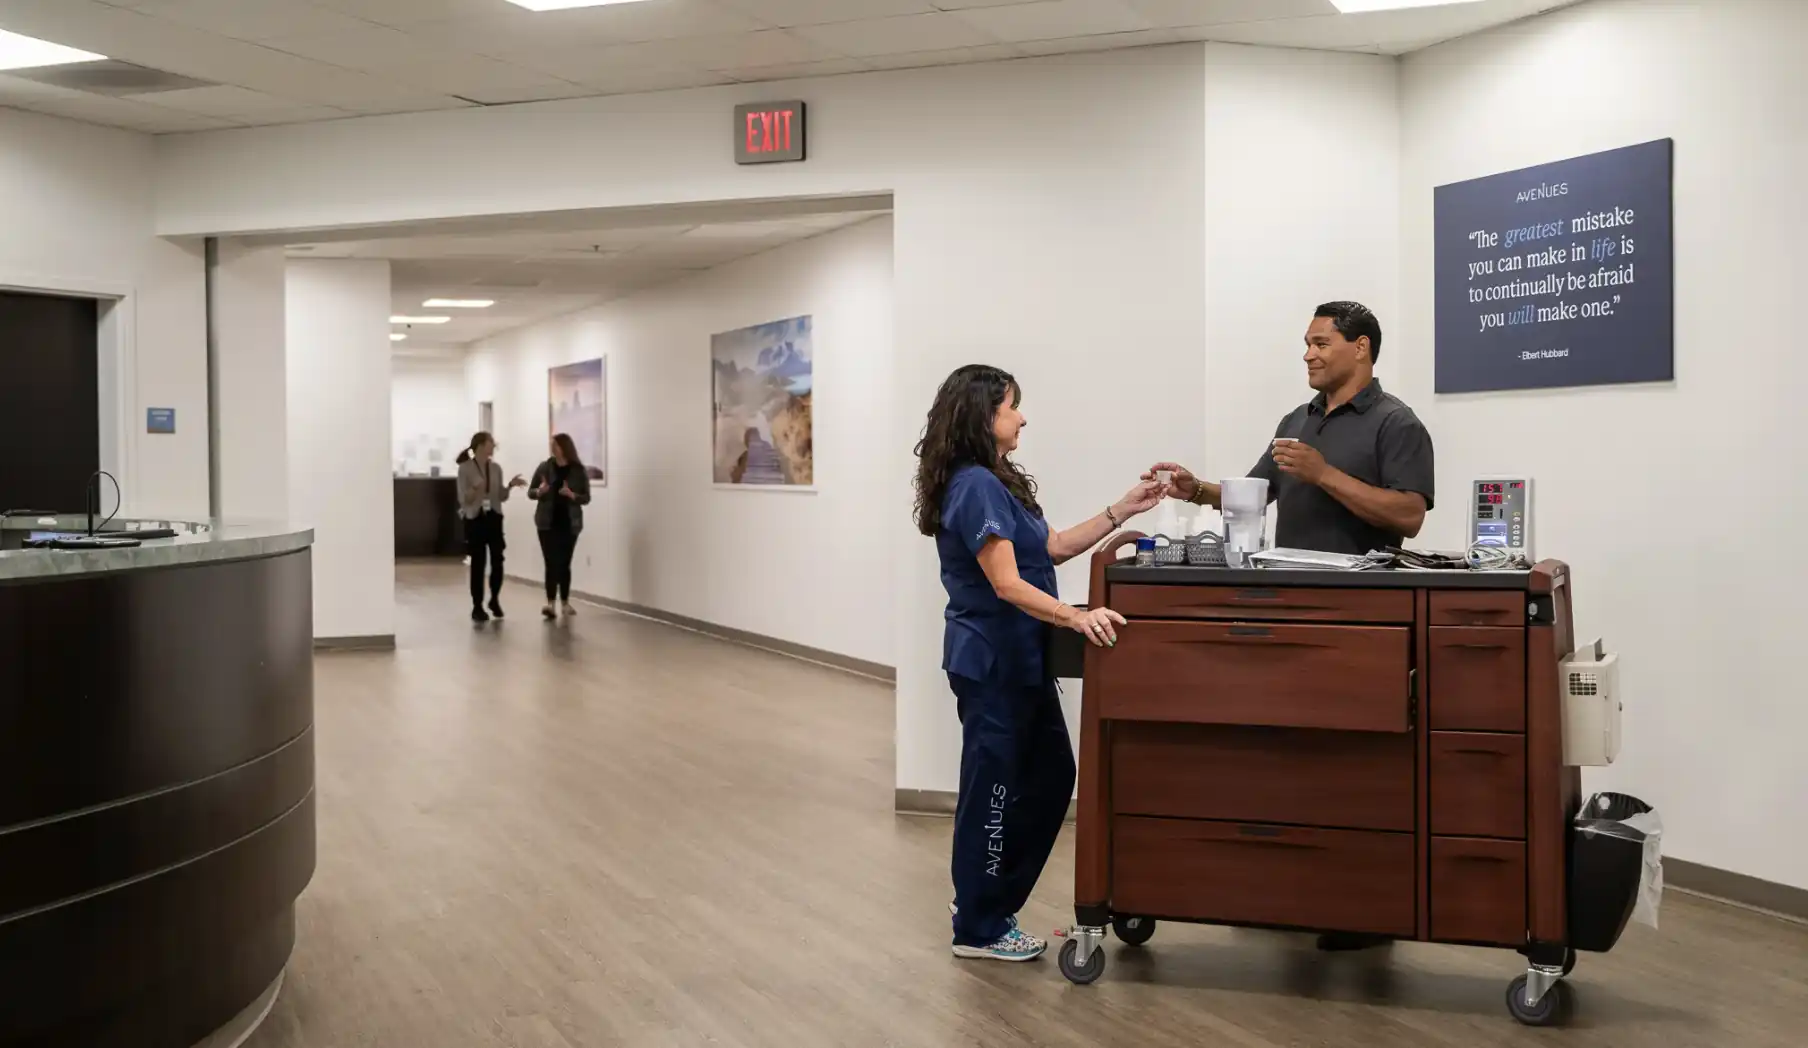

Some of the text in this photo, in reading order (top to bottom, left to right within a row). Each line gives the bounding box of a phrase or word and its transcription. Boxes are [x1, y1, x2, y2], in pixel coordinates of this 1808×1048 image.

[746, 110, 793, 153] EXIT
[1516, 182, 1569, 203] AVENUES
[1504, 219, 1564, 248] greatest
[1572, 206, 1634, 233] mistake
[1468, 234, 1634, 281] you can make in life is
[1469, 263, 1634, 303] to continually be afraid
[1480, 312, 1505, 332] you
[1508, 304, 1535, 325] will
[1537, 300, 1578, 323] make
[1522, 350, 1540, 360] Elbert
[1541, 348, 1569, 359] Hubbard
[984, 783, 1007, 877] AVENUES
